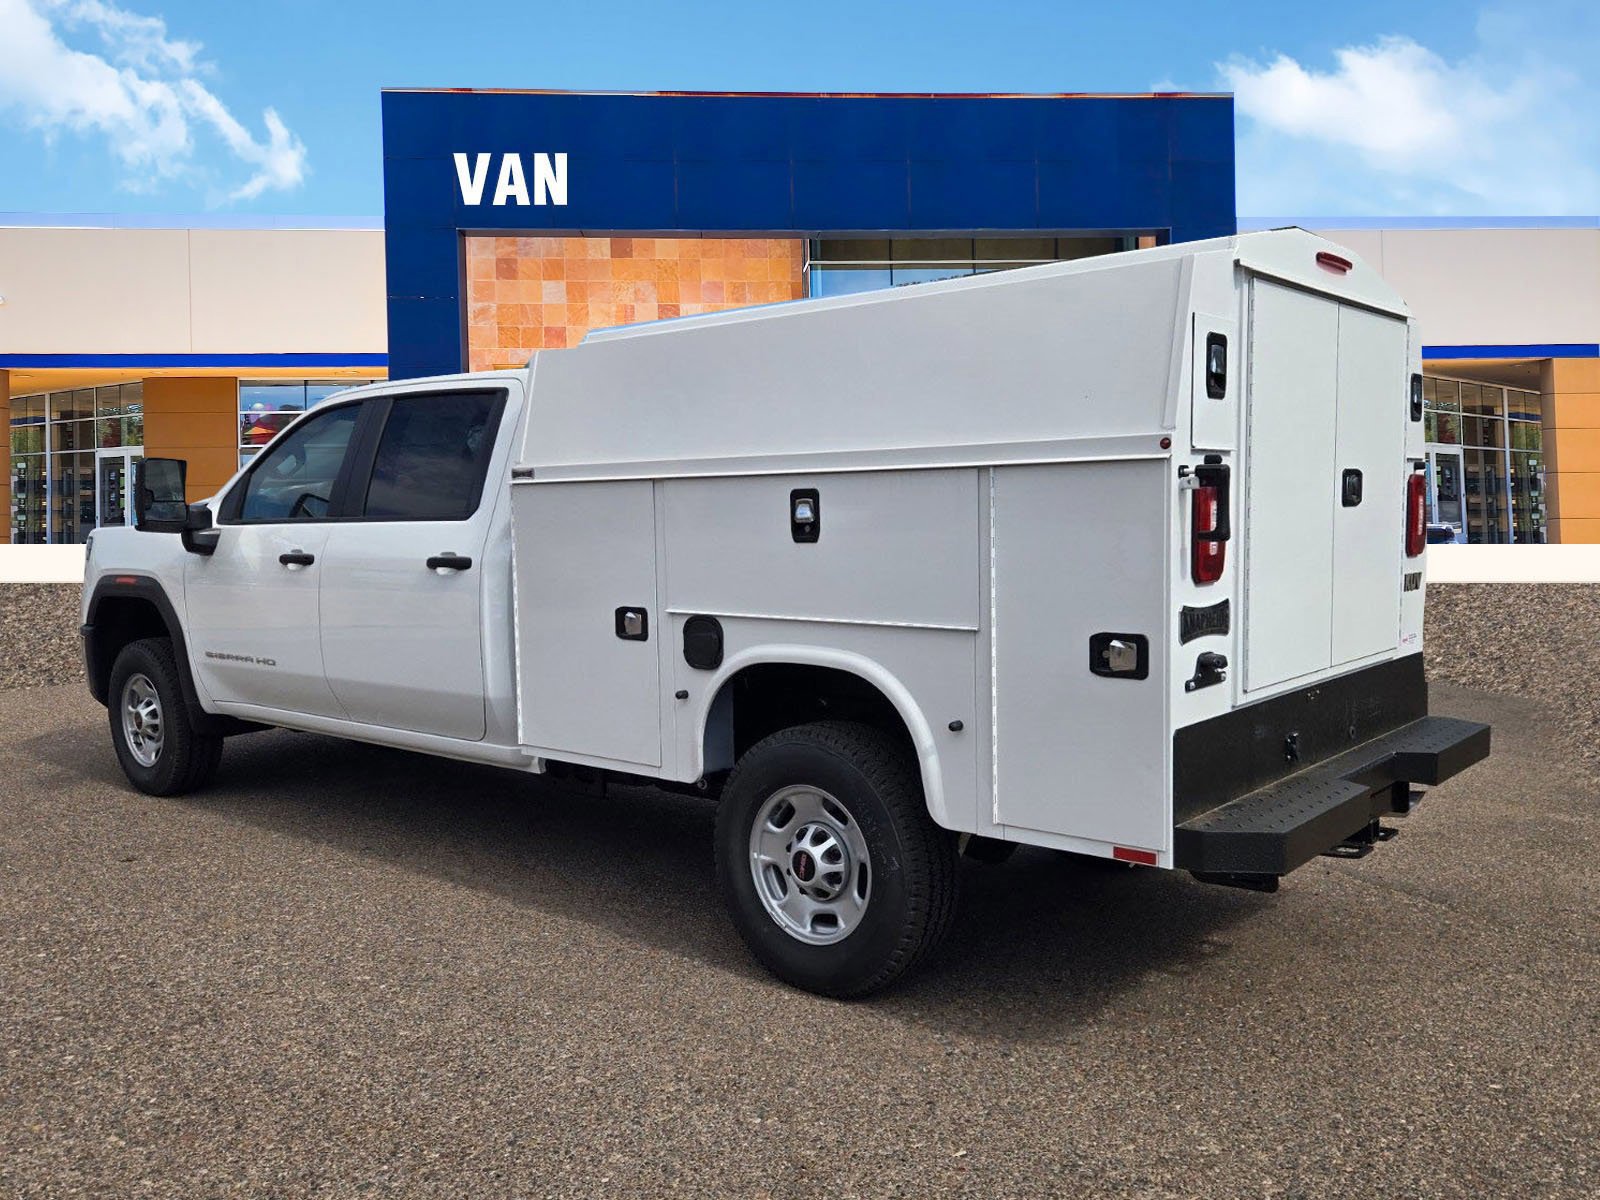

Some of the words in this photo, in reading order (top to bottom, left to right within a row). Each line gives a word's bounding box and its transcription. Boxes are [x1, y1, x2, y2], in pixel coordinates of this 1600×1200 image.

[453, 152, 568, 206] VAN
[205, 651, 254, 664] SIERRA
[256, 657, 277, 667] HD
